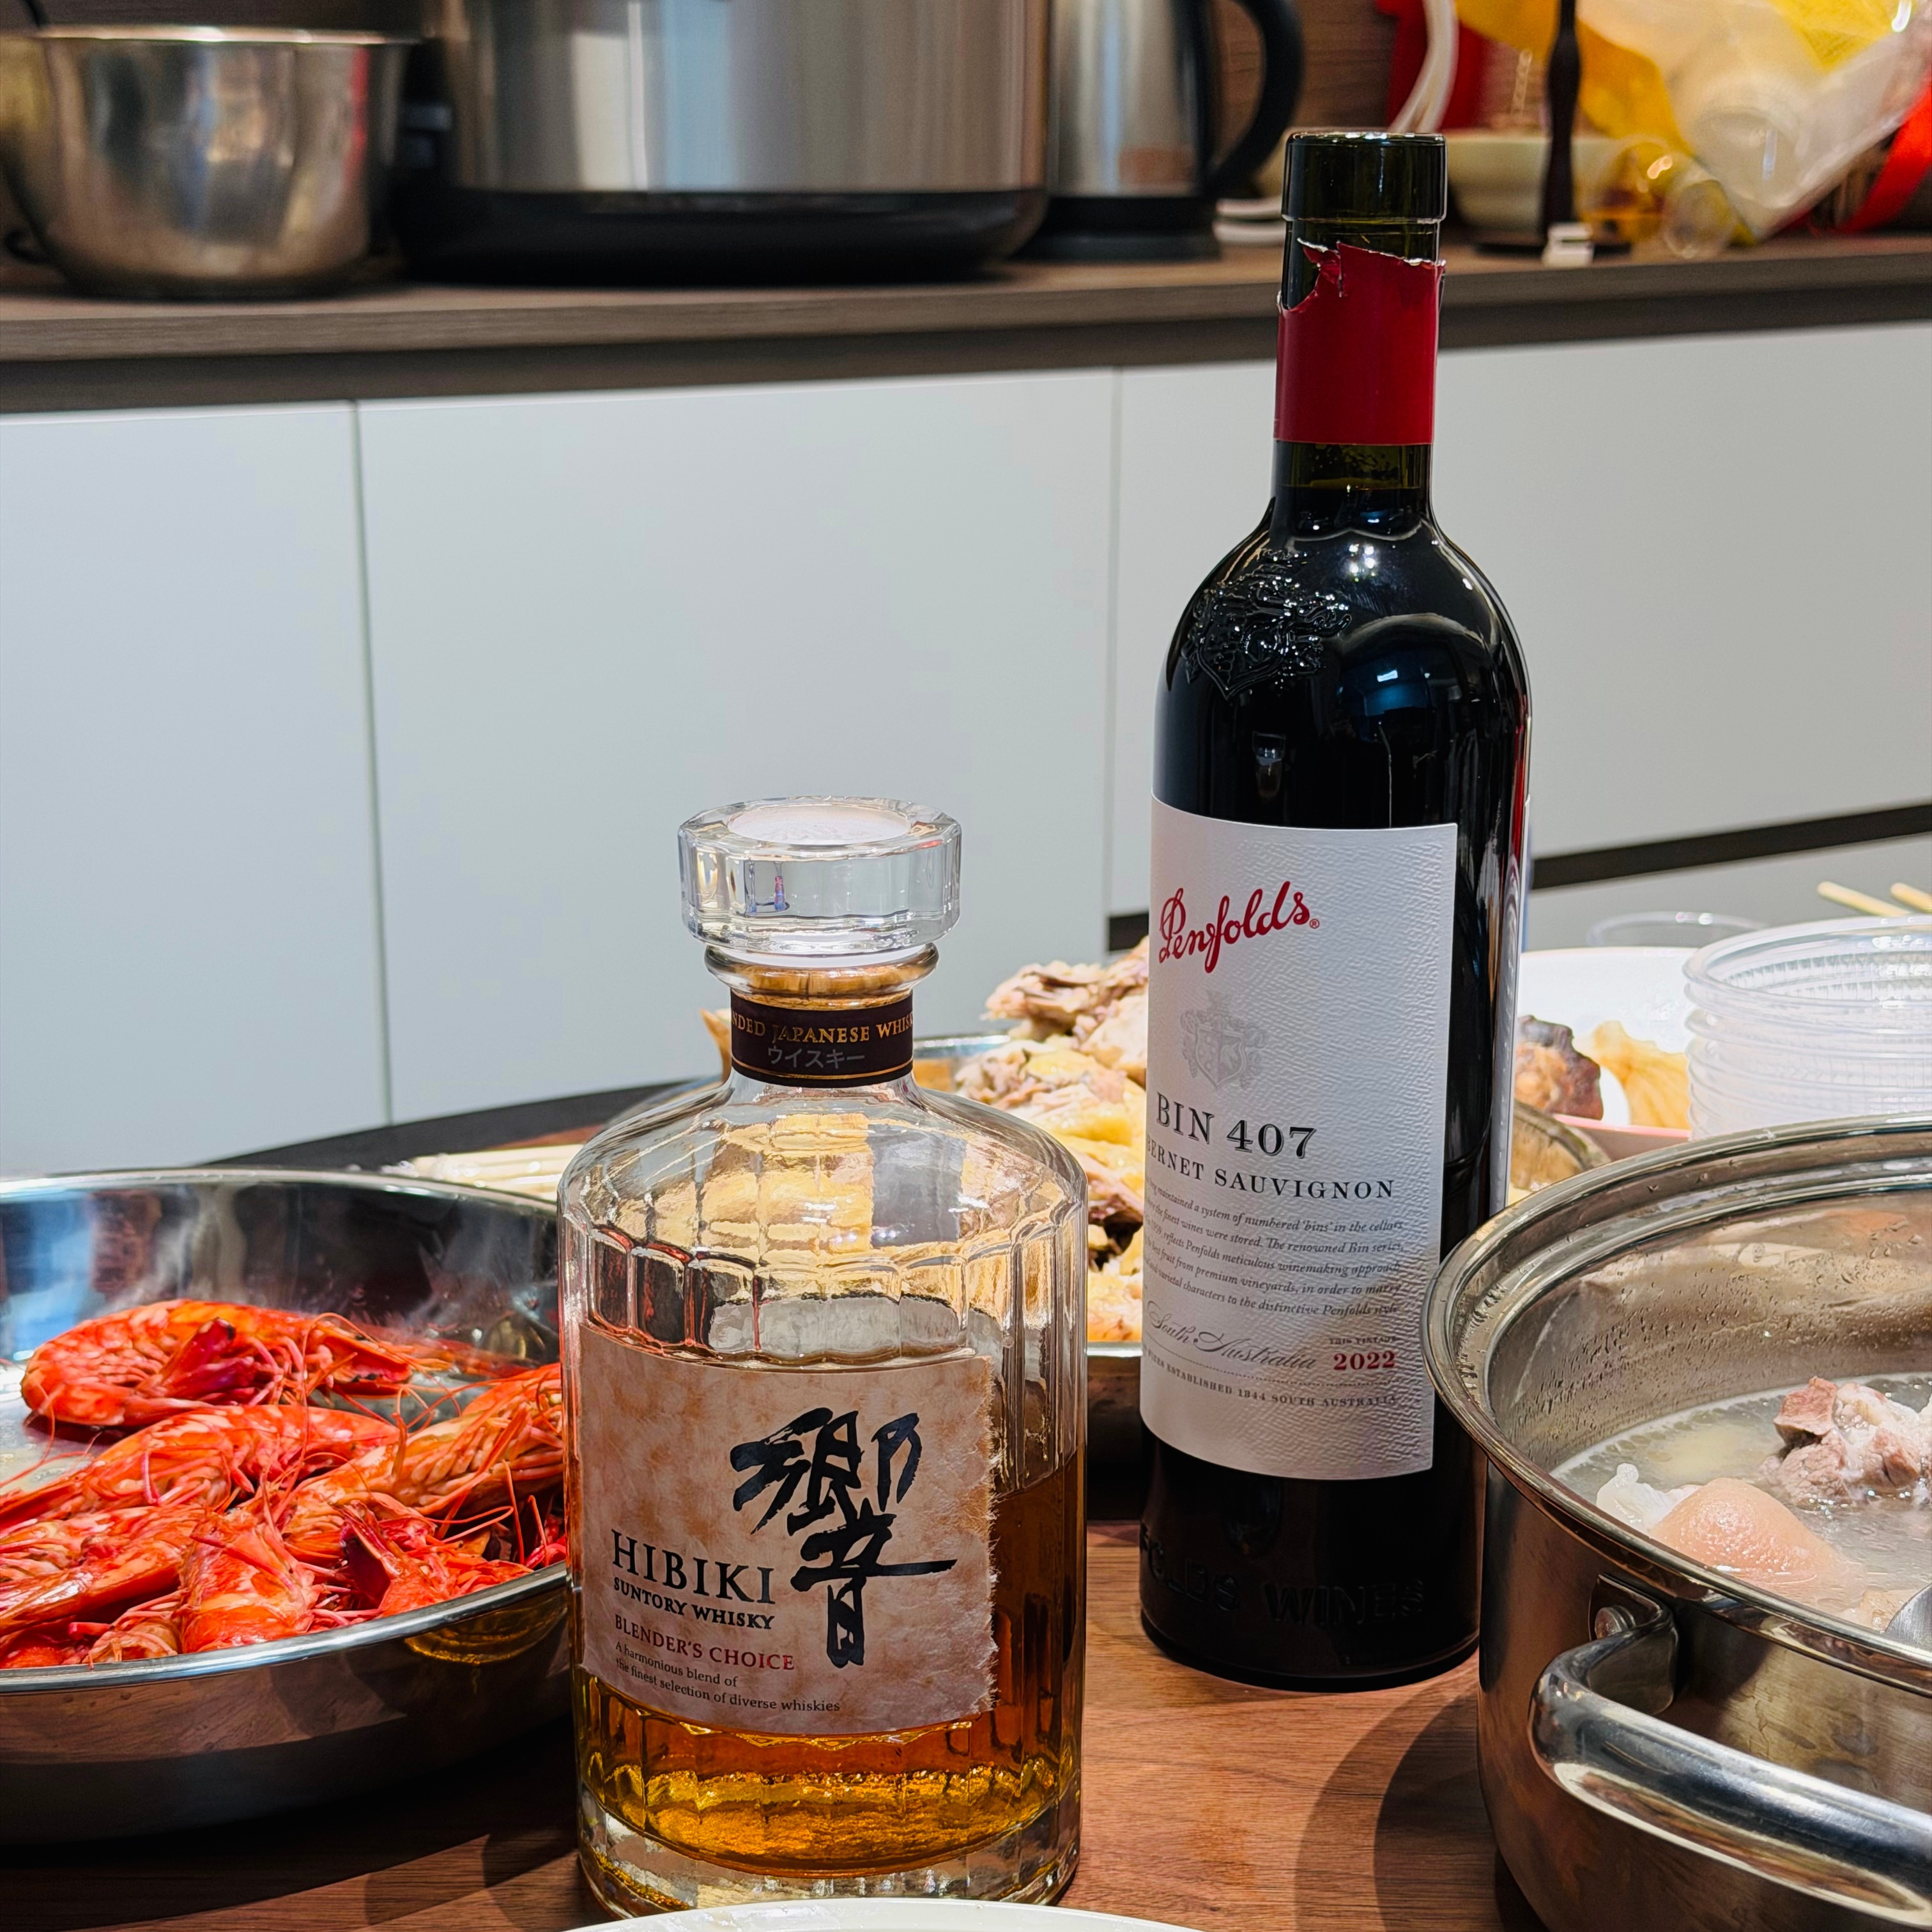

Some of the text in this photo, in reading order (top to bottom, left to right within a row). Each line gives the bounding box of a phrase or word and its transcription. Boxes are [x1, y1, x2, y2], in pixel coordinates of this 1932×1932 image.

[1159, 881, 1310, 973] Penfolds
[772, 1024, 870, 1044] JAPANESE
[768, 1045, 865, 1069] ウイスキー
[1156, 1091, 1317, 1160] BIN 407
[1215, 1168, 1395, 1200] SAUVIGNON
[1181, 1220, 1204, 1234] wines
[1205, 1229, 1228, 1241] were
[1230, 1234, 1263, 1248] stored.
[1266, 1237, 1284, 1250] The
[1287, 1241, 1346, 1254] renowned
[1348, 1241, 1369, 1254] Bin
[1200, 1206, 1230, 1221] system
[1232, 1212, 1246, 1227] of
[1245, 1216, 1300, 1231] numbered
[1333, 1222, 1346, 1232] in
[1349, 1221, 1366, 1232] the
[1174, 1256, 1194, 1273] from
[1195, 1266, 1238, 1285] premium
[1301, 1284, 1314, 1294] in
[1317, 1283, 1349, 1294] order
[1351, 1285, 1361, 1295] to
[1185, 1239, 1220, 1259] Penfolds
[1222, 1252, 1275, 1269] meticulous
[1278, 1261, 1349, 1278] winemaking
[1183, 1281, 1225, 1302] characters
[1227, 1294, 1237, 1305] to
[1239, 1296, 1256, 1308] the
[1258, 1300, 1320, 1315] distinctive
[1147, 1301, 1317, 1369] South Australia
[1333, 1350, 1396, 1370] 2022
[1167, 1363, 1232, 1394] ESTABLISHED
[1238, 1388, 1266, 1401] 1844
[1271, 1394, 1315, 1406] SOUTH
[730, 1407, 957, 1668] 響
[611, 1528, 776, 1605] HIBIKI
[613, 1576, 776, 1630] SUNTORY WHISKY
[615, 1613, 795, 1670] BLENDER'S CHOICE
[615, 1641, 739, 1687] A harmonious blend of
[616, 1657, 840, 1712] the finest selection of diverse whiskies
